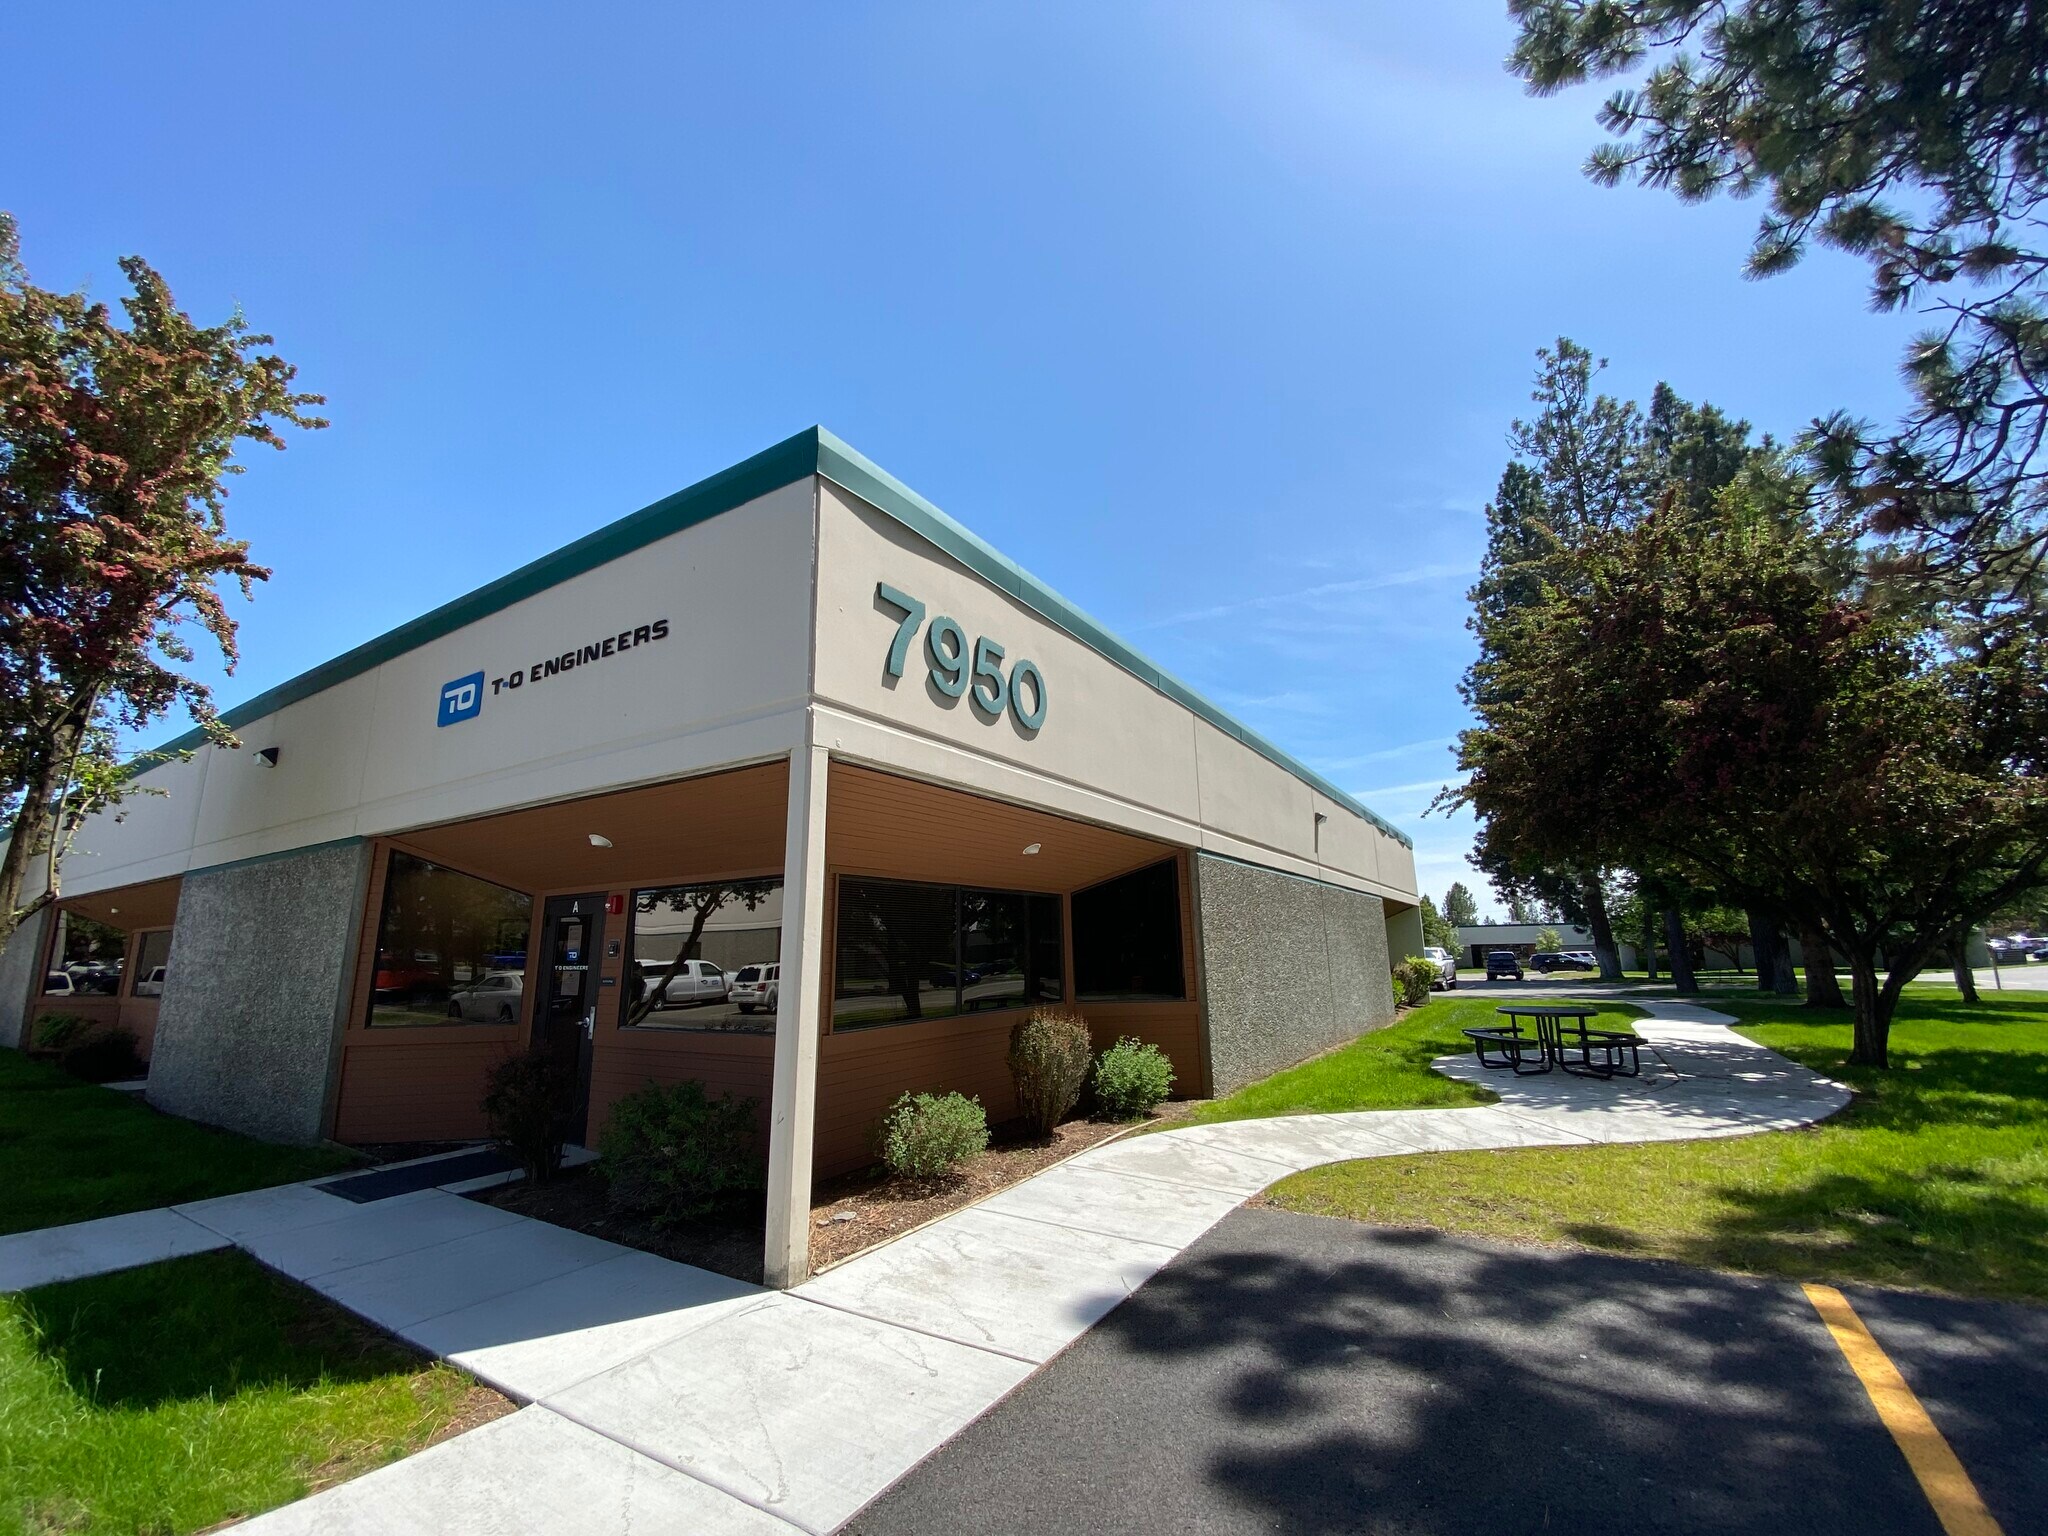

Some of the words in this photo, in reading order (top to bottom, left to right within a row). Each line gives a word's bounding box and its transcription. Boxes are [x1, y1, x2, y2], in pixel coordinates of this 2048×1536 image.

[530, 619, 668, 683] ENGINEERS
[877, 581, 1047, 730] 7950
[572, 901, 579, 914] A
